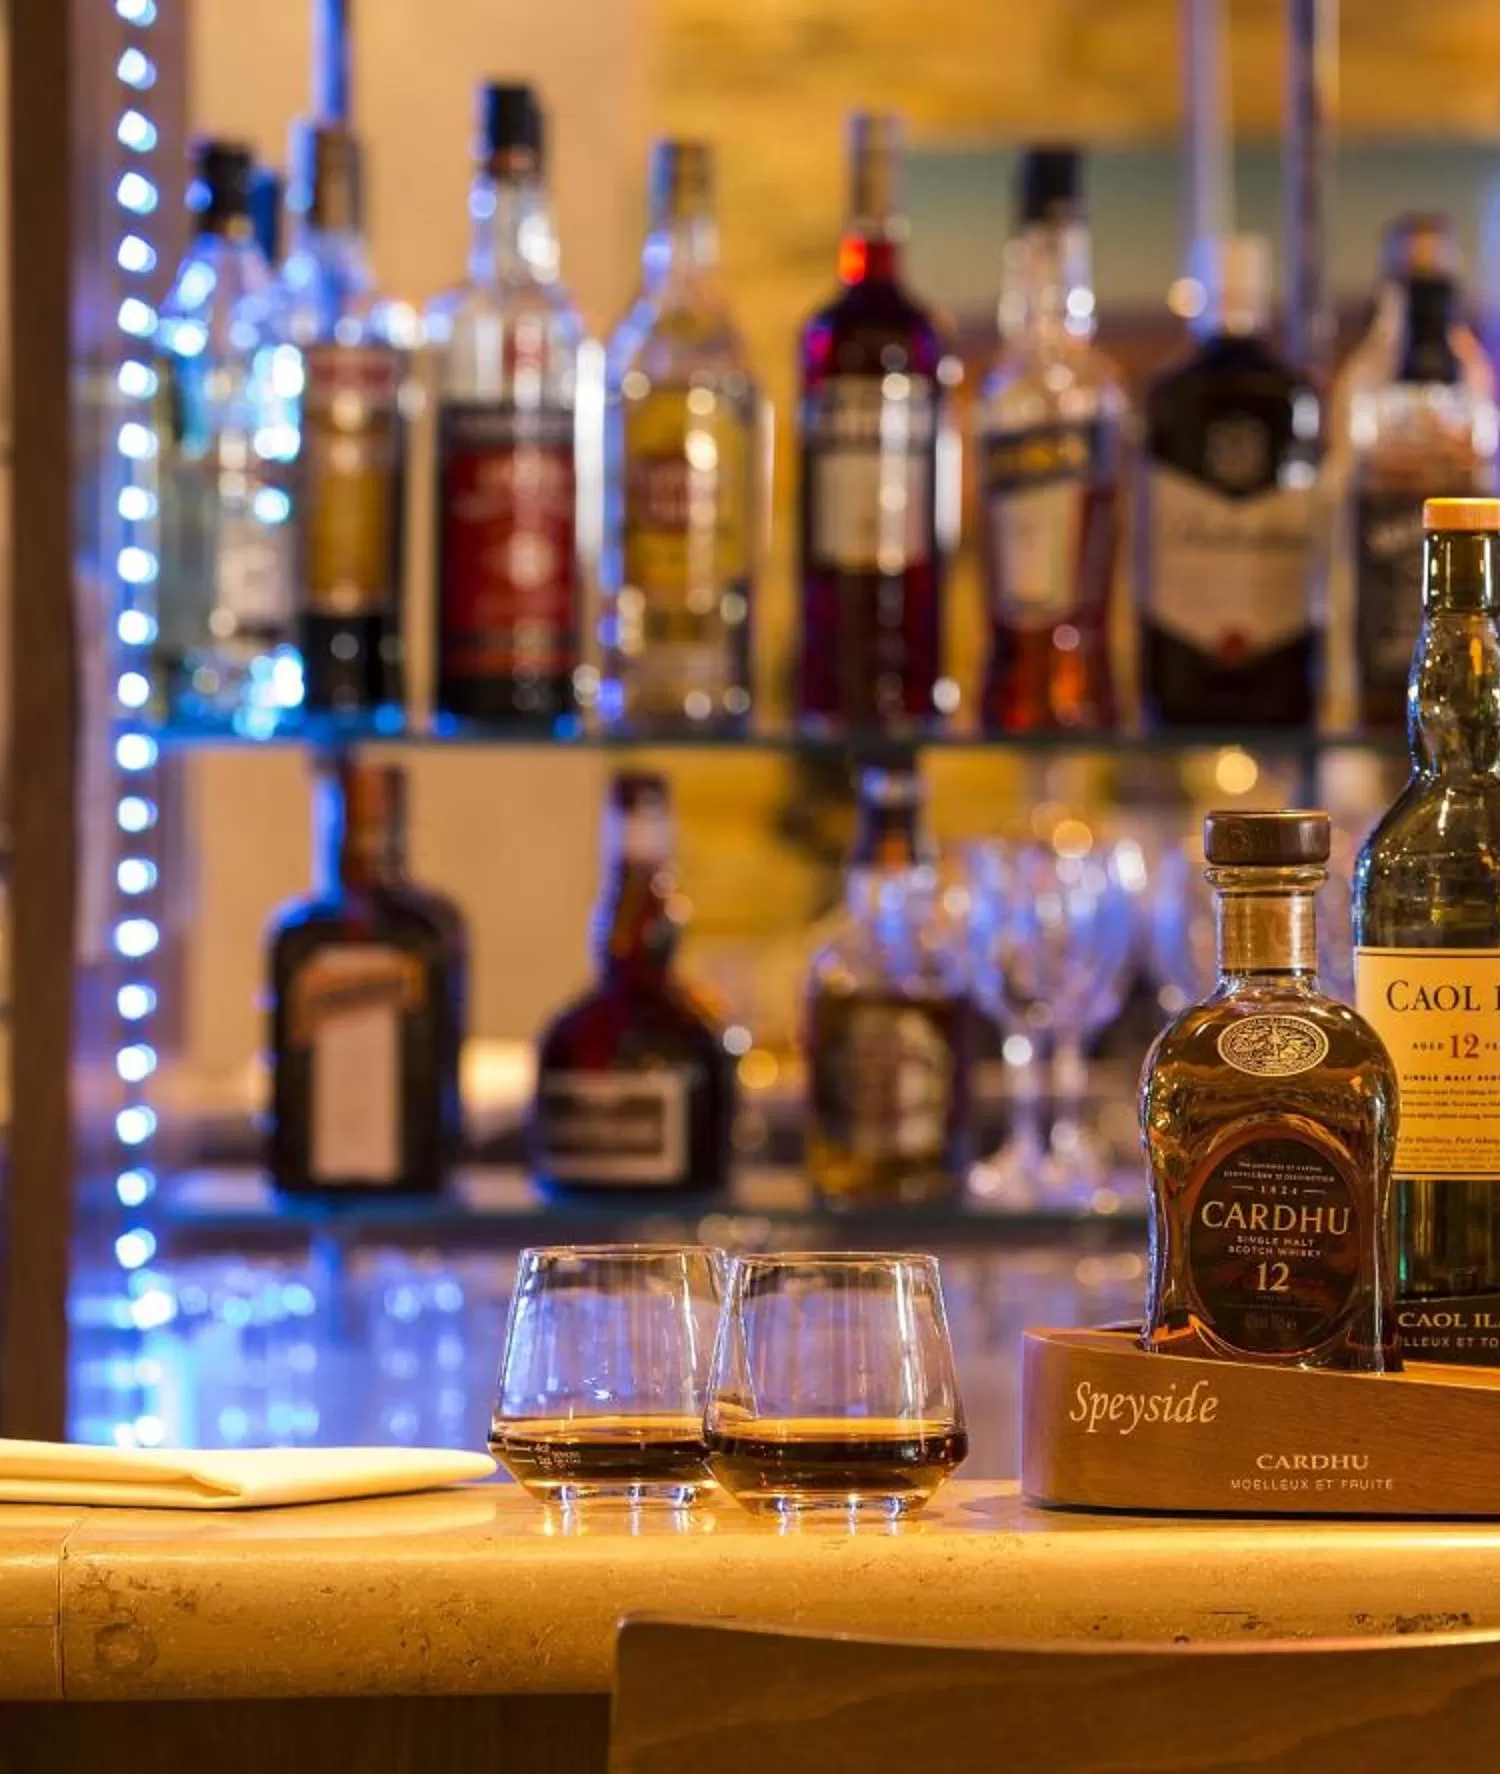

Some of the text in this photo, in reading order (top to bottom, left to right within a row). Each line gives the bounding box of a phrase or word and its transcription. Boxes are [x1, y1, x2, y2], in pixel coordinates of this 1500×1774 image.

[1386, 979, 1480, 1012] CAOL
[1450, 1032, 1480, 1059] 12
[1201, 1200, 1350, 1235] CARDHU
[1257, 1261, 1291, 1293] 12
[1398, 1312, 1468, 1329] CAOL
[1403, 1336, 1450, 1348] LLEUX
[1456, 1337, 1475, 1348] ET
[1069, 1379, 1219, 1436] Speyside
[1255, 1453, 1370, 1471] CARDHU
[1231, 1479, 1309, 1491] MOELLEUX
[1316, 1479, 1335, 1491] ET
